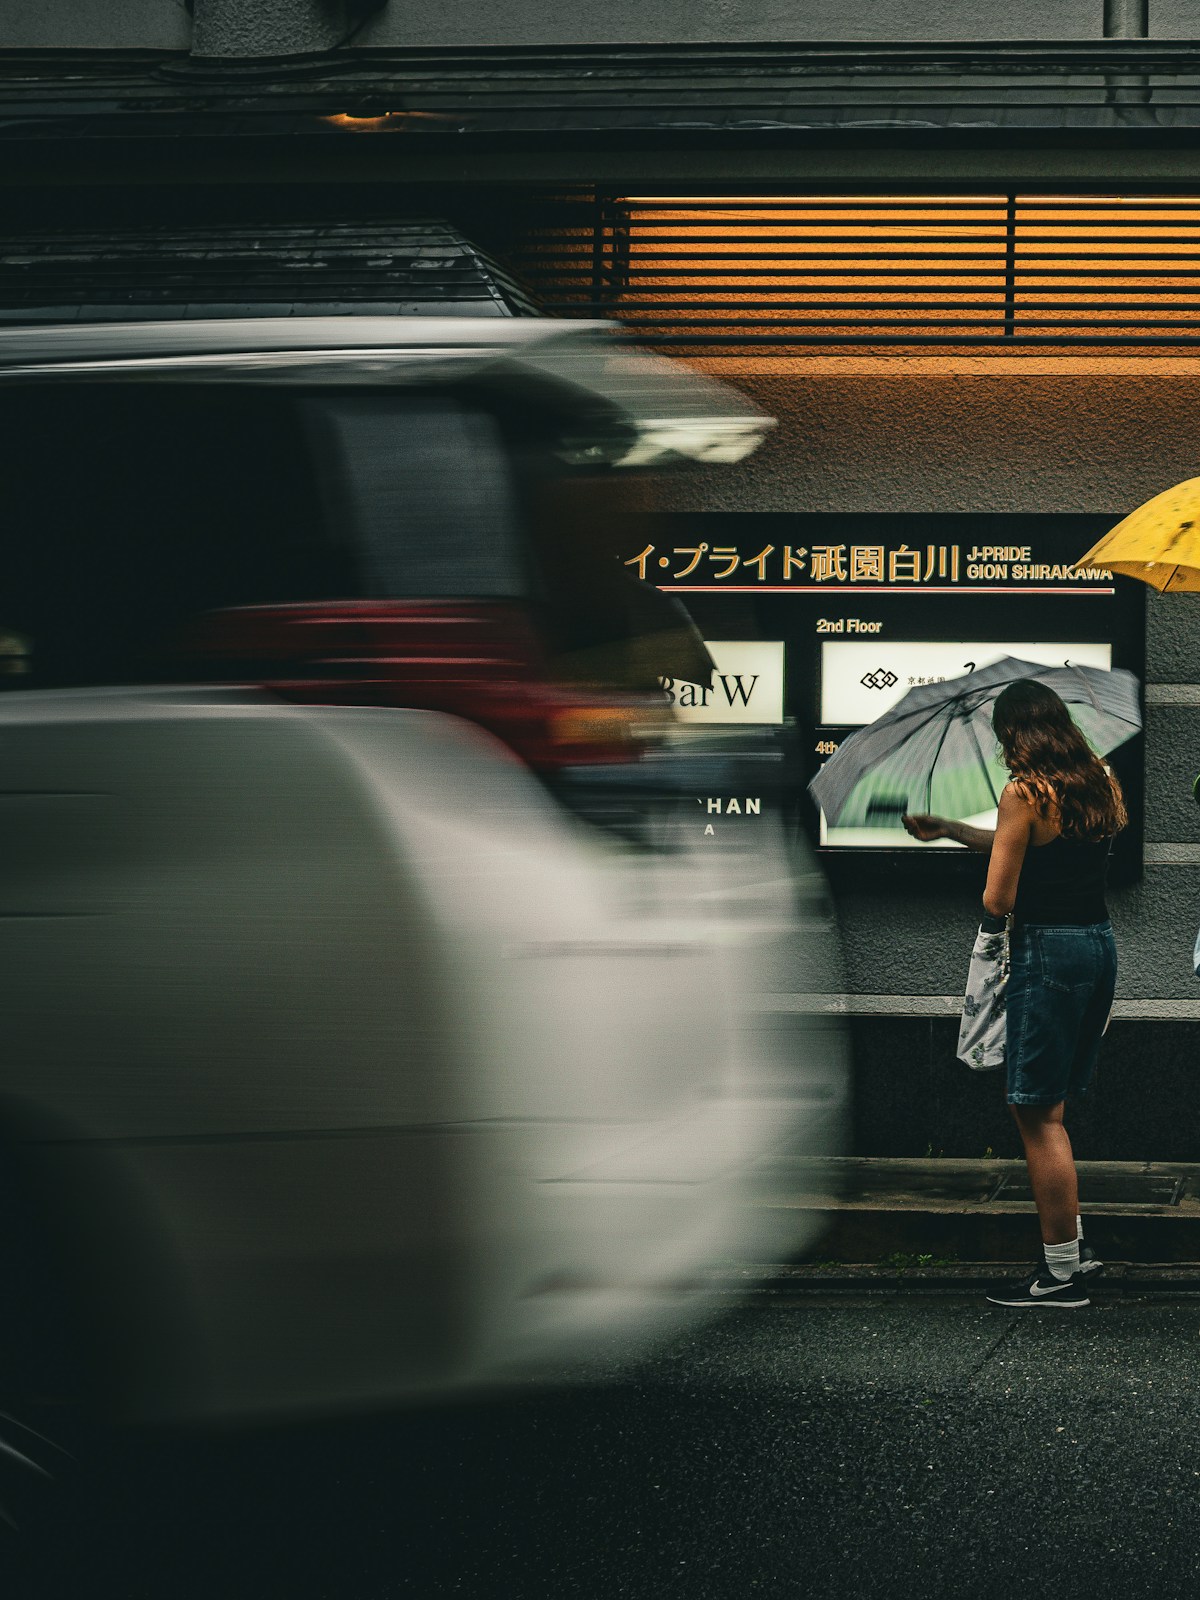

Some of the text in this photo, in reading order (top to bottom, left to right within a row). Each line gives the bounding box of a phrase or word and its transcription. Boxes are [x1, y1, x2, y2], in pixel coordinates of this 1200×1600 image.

[966, 546, 1031, 562] J-PRIDE
[966, 564, 1114, 581] GION SHIRAKAWA
[816, 618, 883, 633] 2nd Floor
[717, 674, 760, 708] W
[814, 740, 839, 755] 4th
[697, 798, 761, 815] HAN
